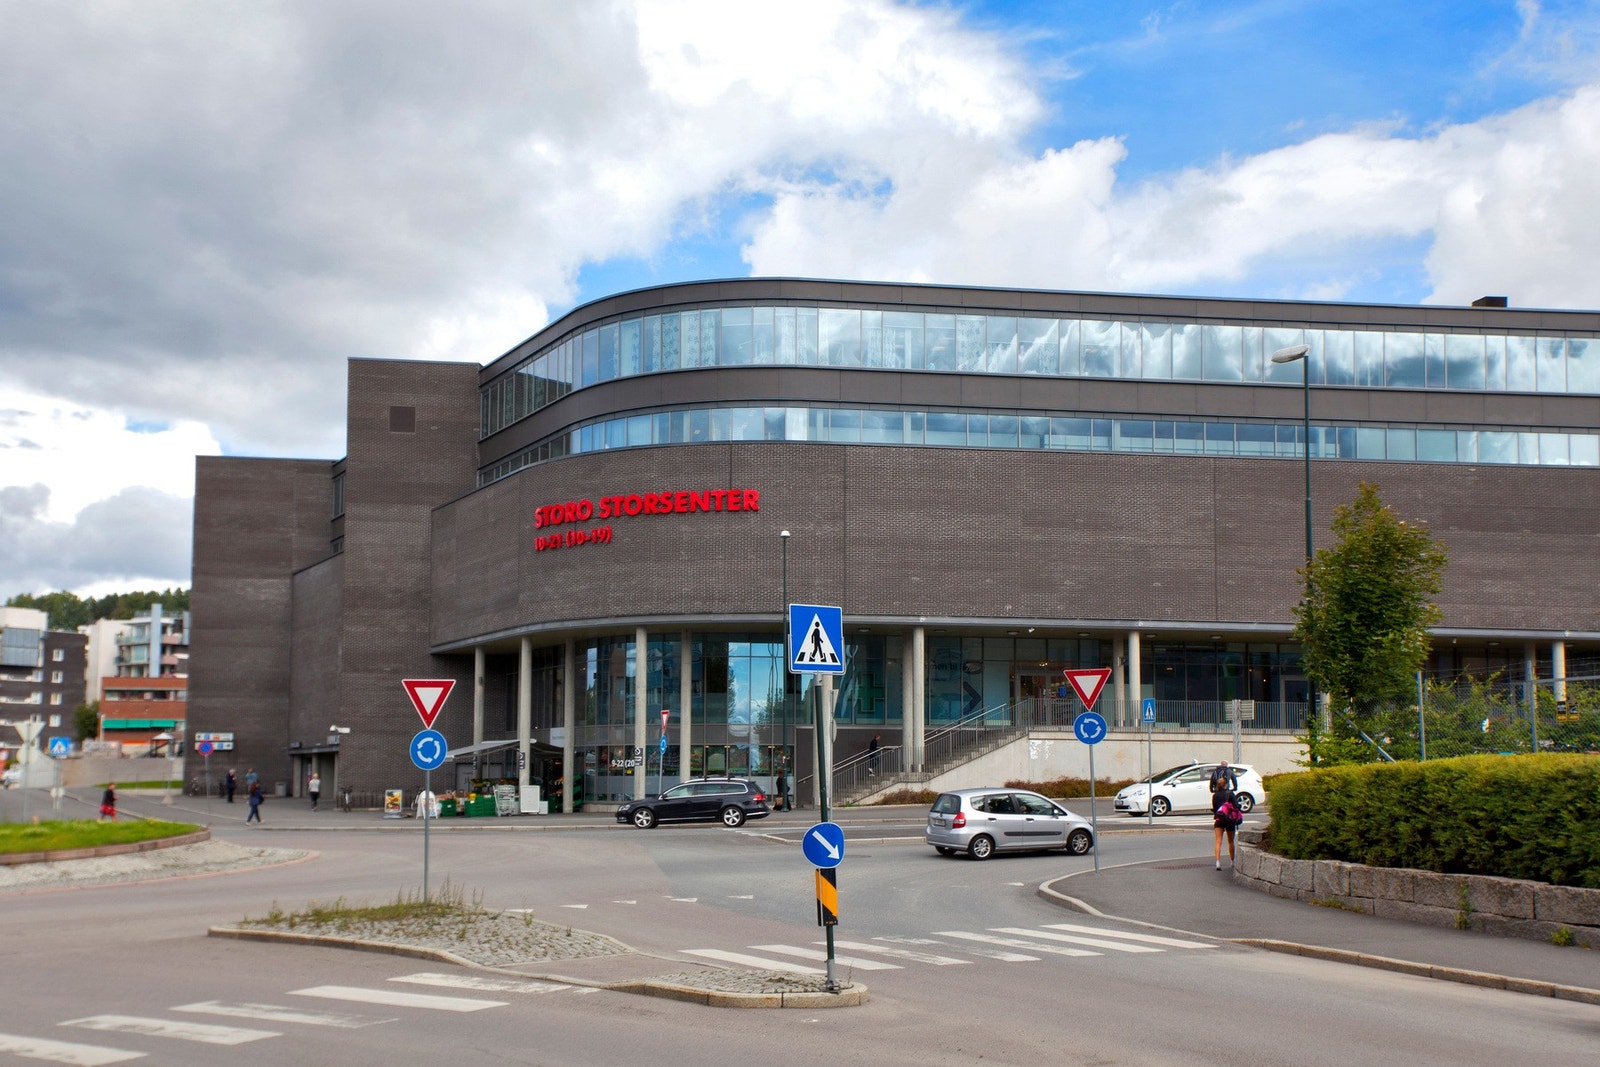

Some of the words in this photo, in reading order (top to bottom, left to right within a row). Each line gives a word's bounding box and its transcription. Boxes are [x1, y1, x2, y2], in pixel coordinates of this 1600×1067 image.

[534, 498, 594, 529] STORO
[598, 489, 760, 519] STORSENTER
[534, 533, 563, 551] 10-21
[566, 525, 613, 548] (10-19)
